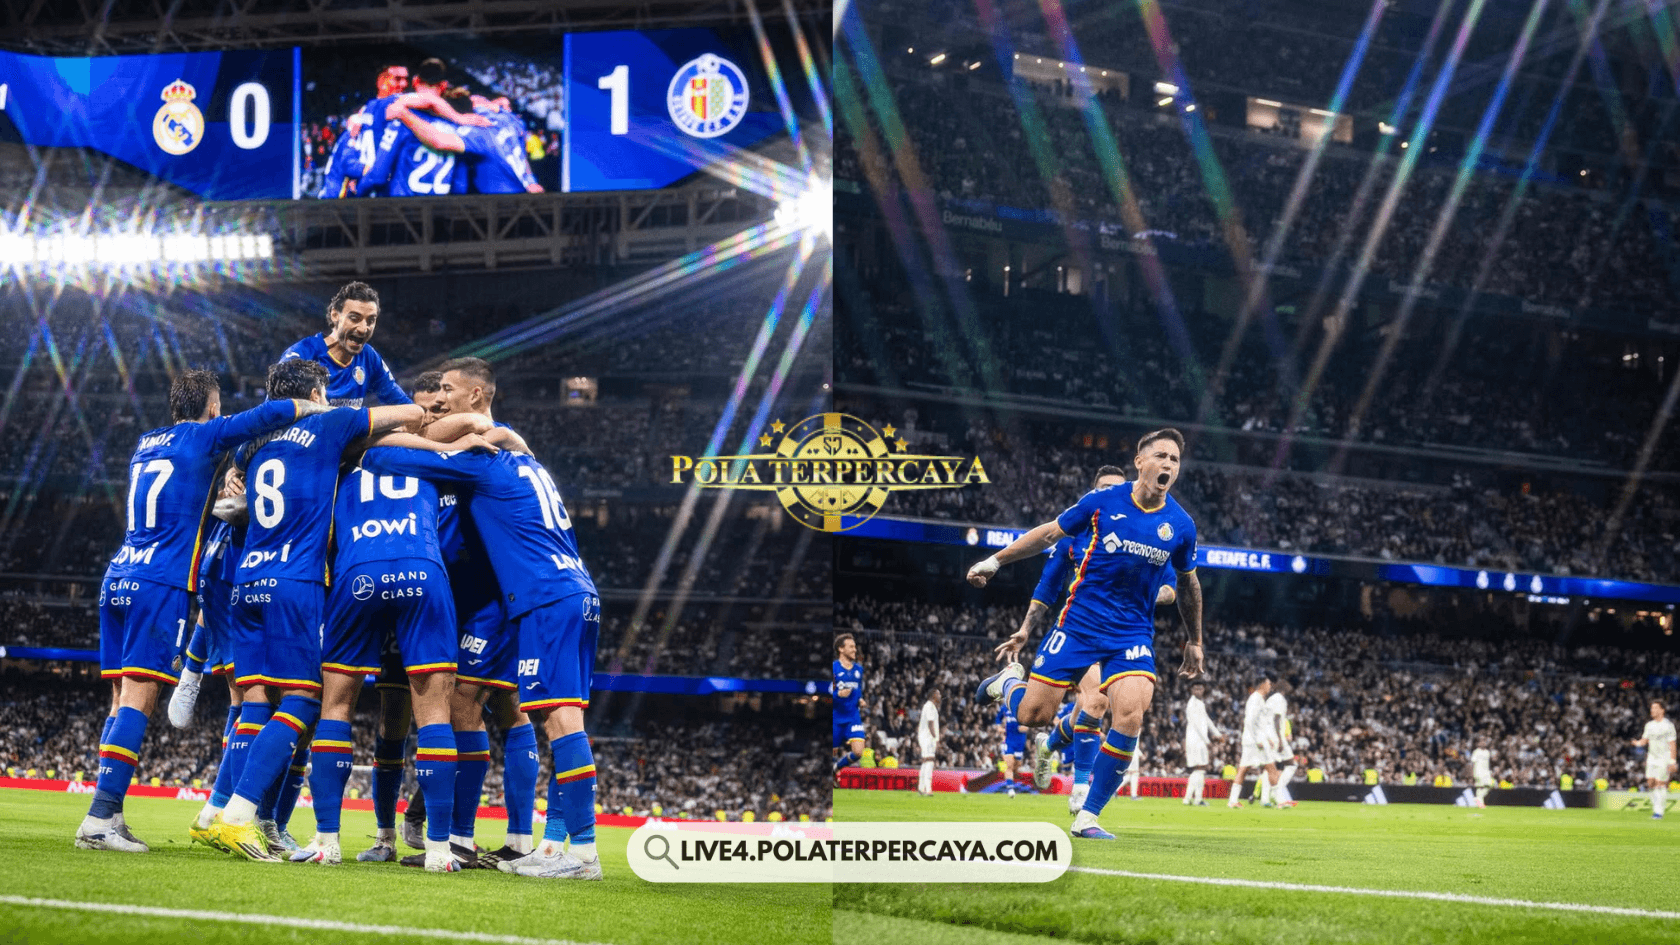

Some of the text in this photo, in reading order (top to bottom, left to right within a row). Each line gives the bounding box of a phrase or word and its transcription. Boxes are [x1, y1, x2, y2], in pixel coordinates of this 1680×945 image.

[229, 82, 271, 150] 0
[598, 65, 629, 135] 1
[128, 459, 174, 531] 17
[254, 458, 286, 529] 8
[518, 465, 573, 531] 16
[381, 571, 428, 583] GRAND
[1042, 629, 1067, 655] 10
